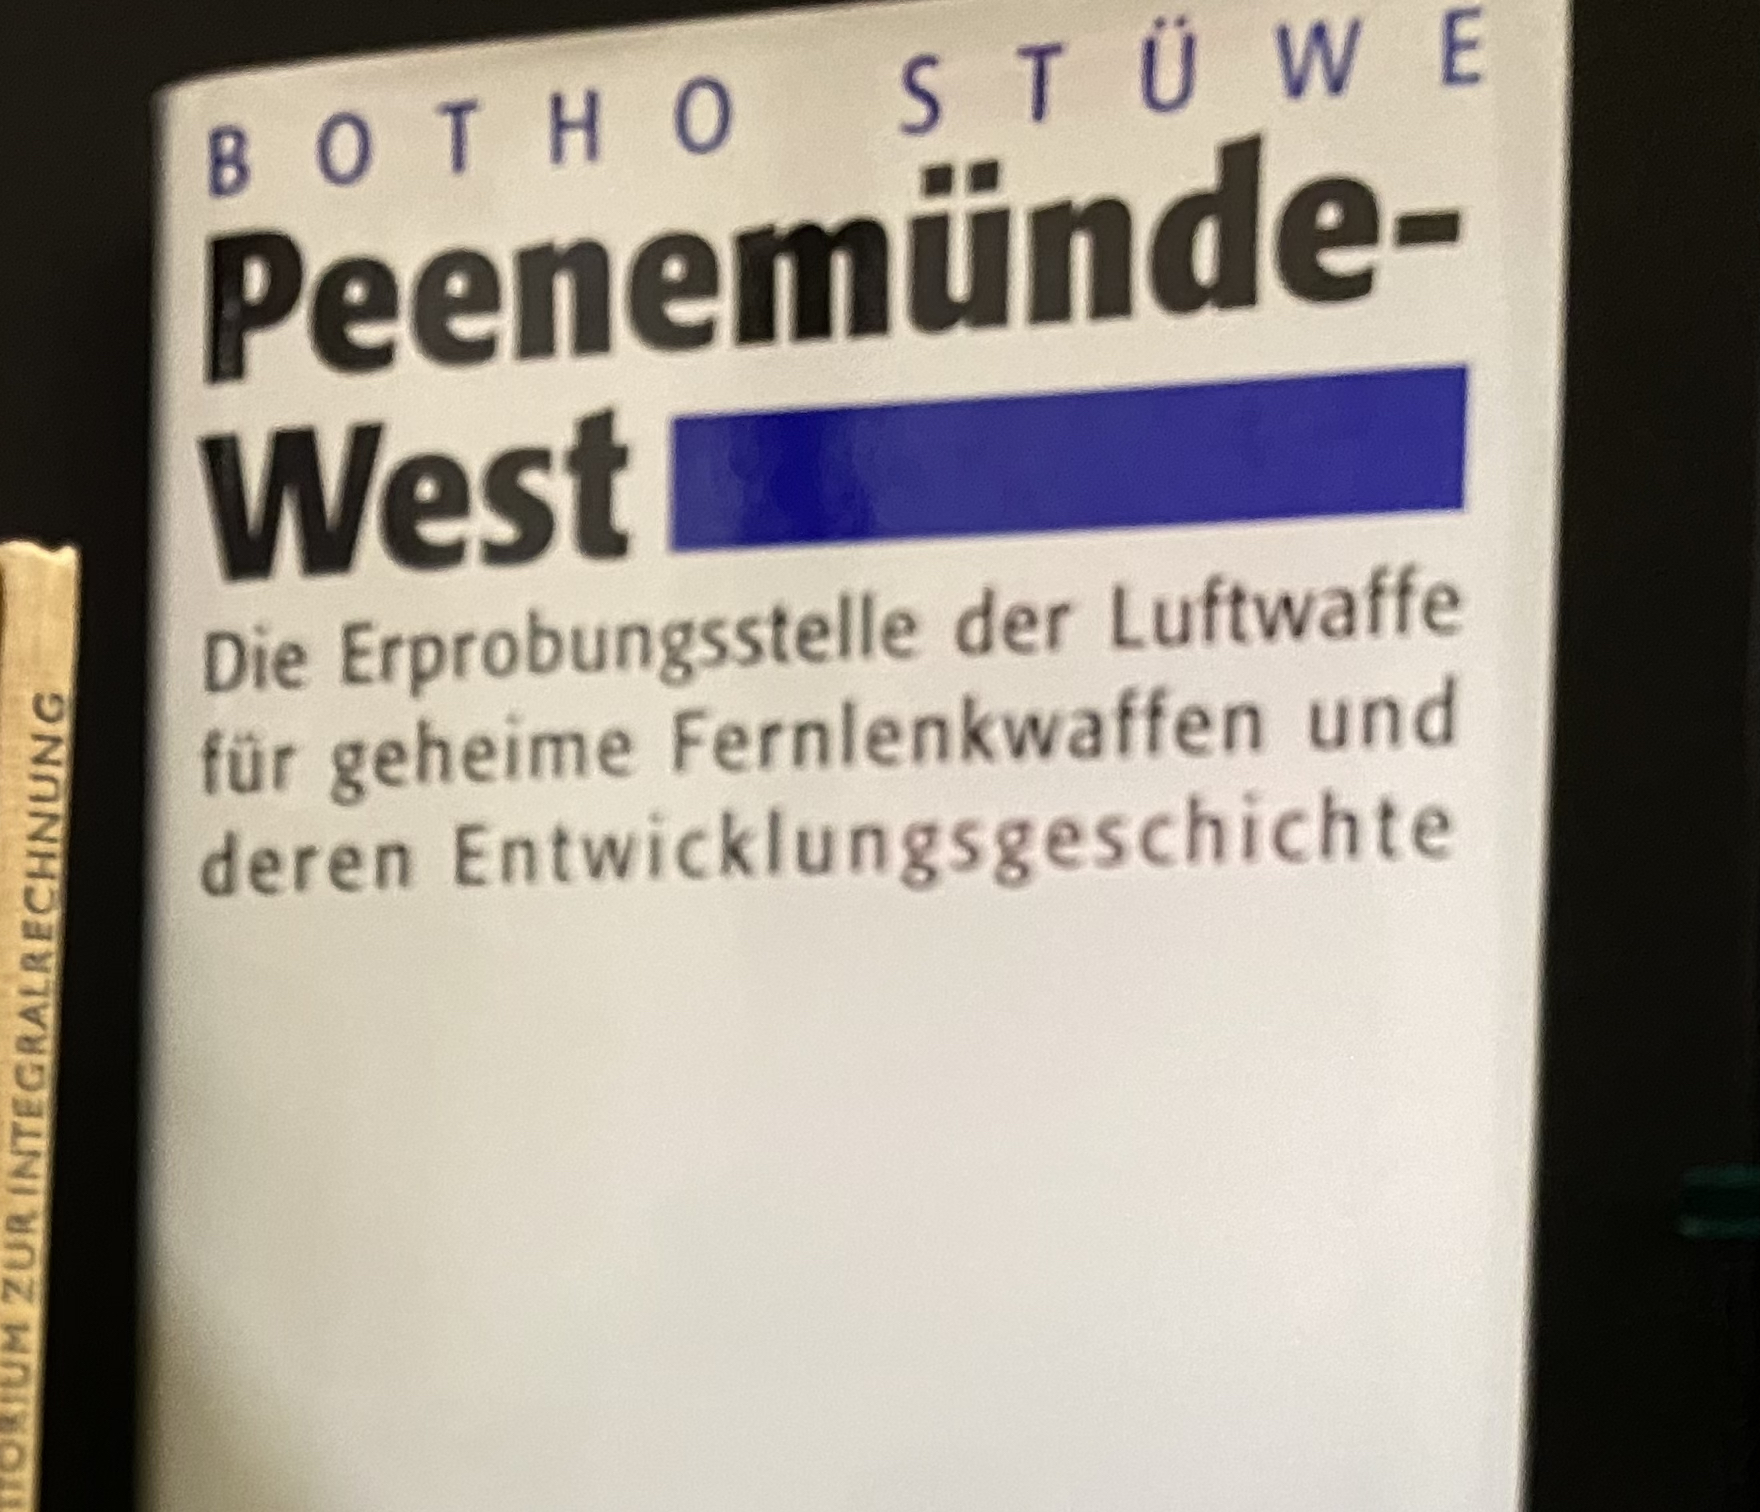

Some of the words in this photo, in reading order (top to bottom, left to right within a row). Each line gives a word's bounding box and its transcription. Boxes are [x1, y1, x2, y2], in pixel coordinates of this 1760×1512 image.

[209, 76, 733, 196] BOTHO
[898, 6, 1486, 134] STÜWE
[203, 134, 1462, 386] Peenemünde-
[197, 407, 631, 582] West
[203, 627, 308, 695] Die
[341, 594, 916, 699] Erprobungsstelle
[954, 584, 1072, 657] der
[1109, 566, 1462, 651] Luftwaffe
[201, 728, 298, 796] für
[328, 709, 631, 805] geheime
[672, 687, 1264, 773] Fernlenkwaffen
[1307, 674, 1458, 750] und
[201, 829, 411, 899] deren
[452, 793, 1452, 891] Entwicklungsgeschichte
[3, 691, 67, 1196] INTEGRALRECHNUNG
[0, 1213, 39, 1304] ZUR
